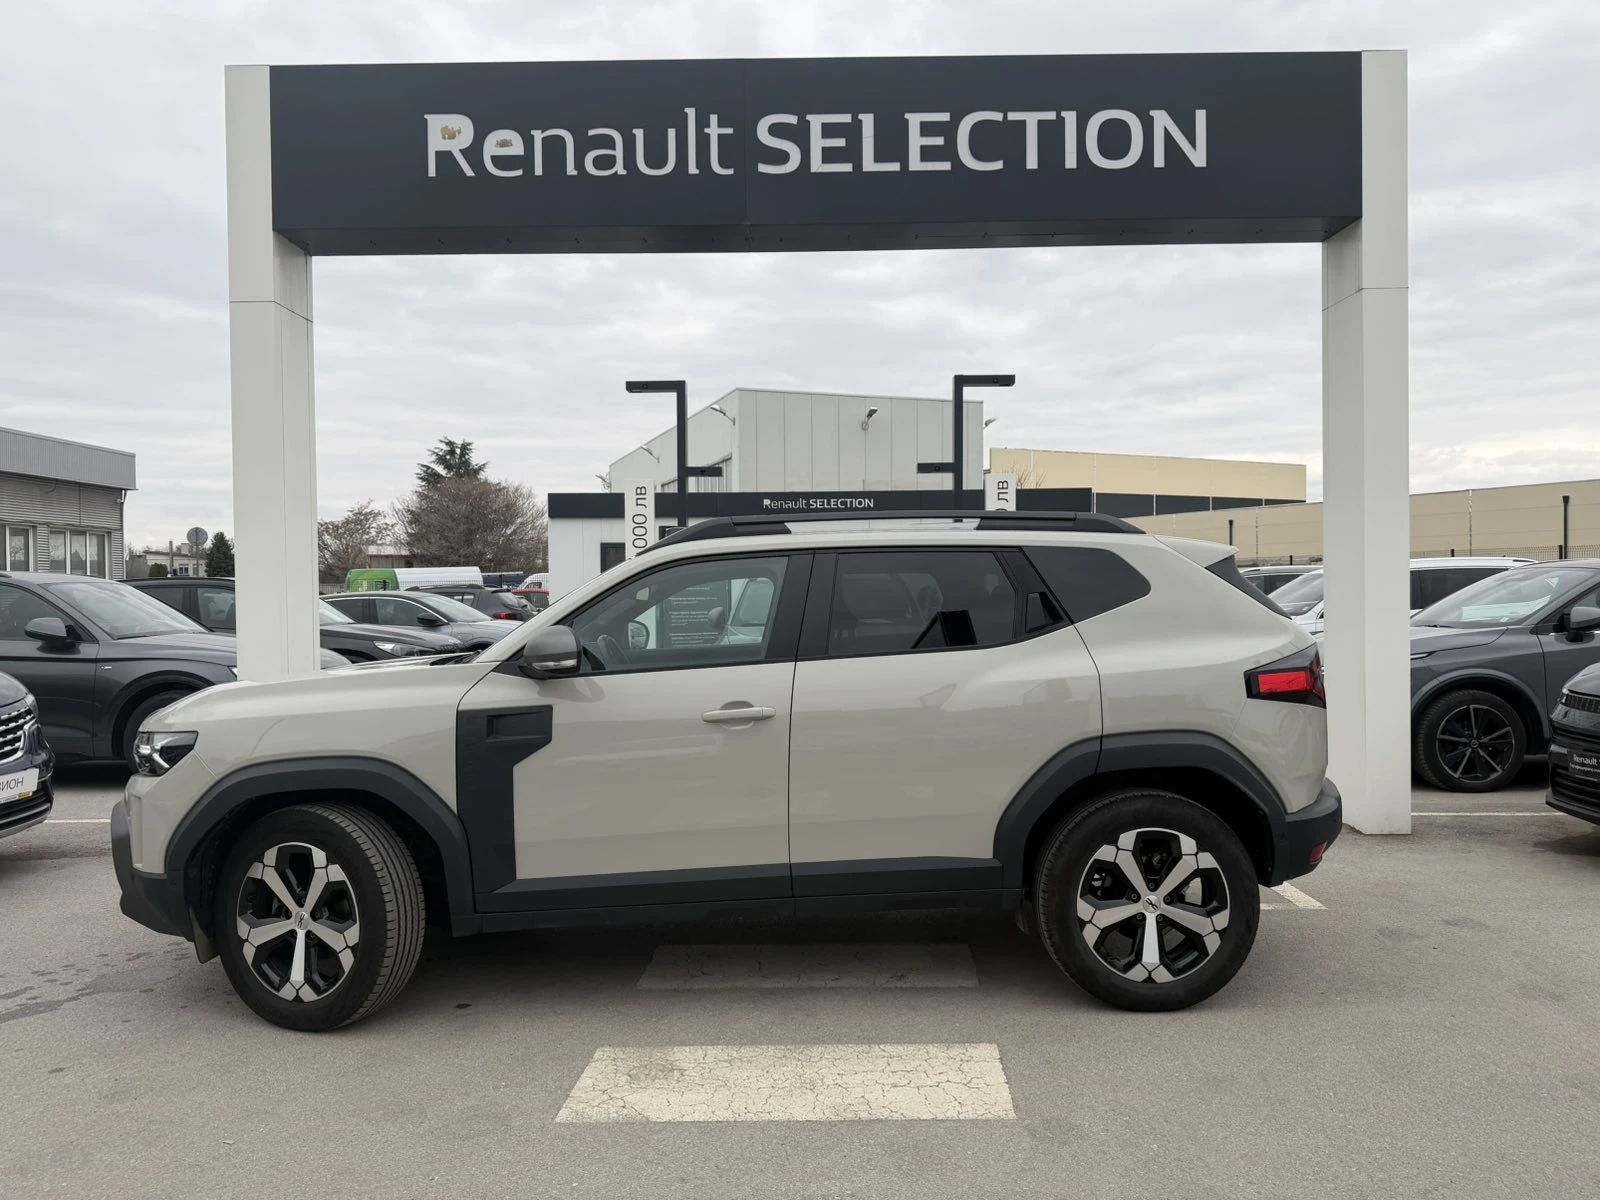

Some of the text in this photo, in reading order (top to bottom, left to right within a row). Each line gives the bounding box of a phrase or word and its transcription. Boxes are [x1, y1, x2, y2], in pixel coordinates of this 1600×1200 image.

[424, 107, 1207, 177] Renault SELECTION
[763, 498, 874, 509] Renault SELECTION
[0, 777, 24, 791] ИОН
